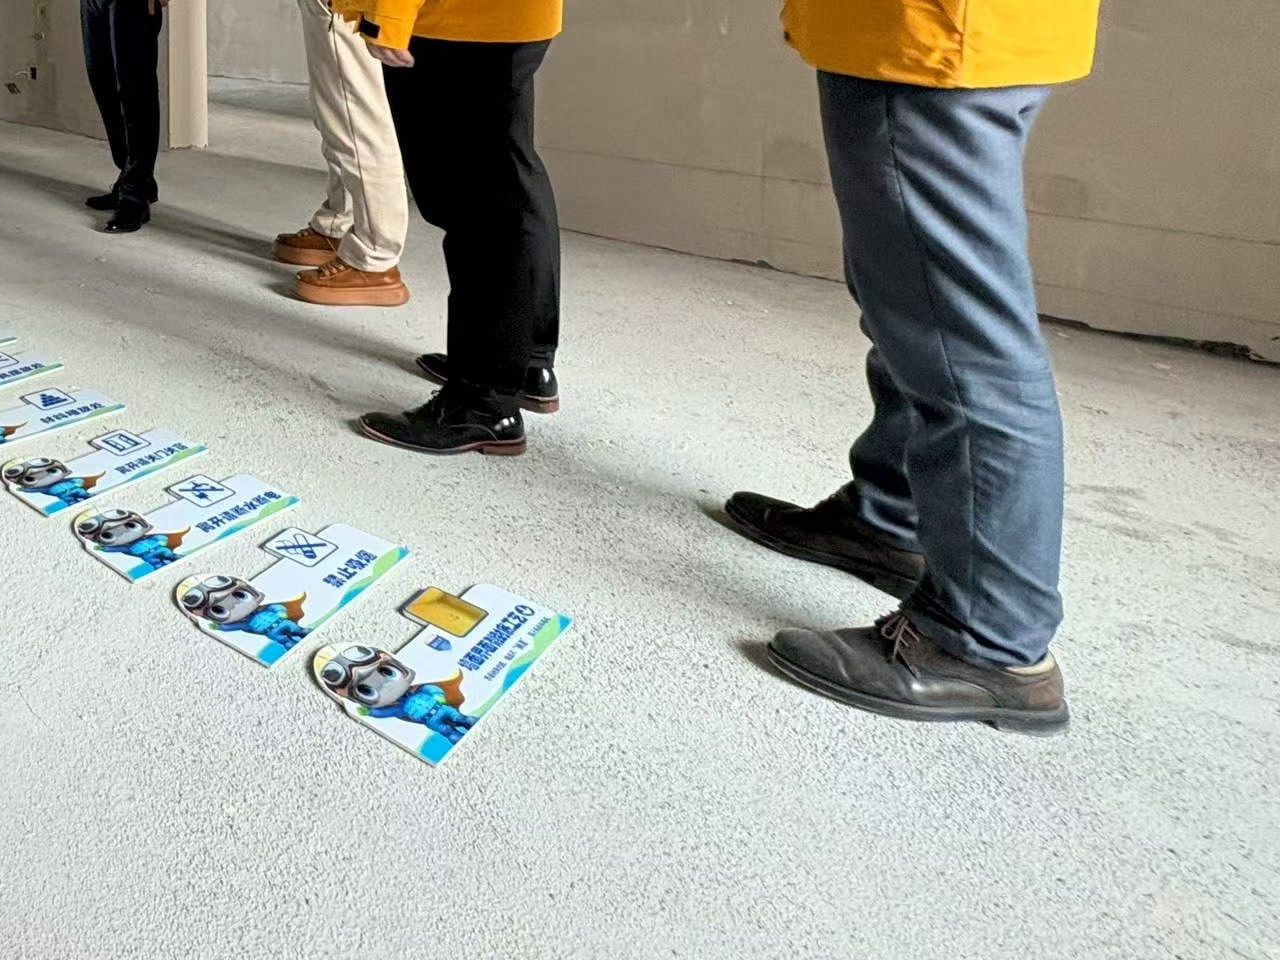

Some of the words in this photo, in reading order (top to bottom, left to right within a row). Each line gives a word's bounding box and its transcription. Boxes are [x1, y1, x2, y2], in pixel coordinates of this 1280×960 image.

[196, 490, 282, 533] 离开请断水断电
[323, 549, 377, 588] 禁止吸烟
